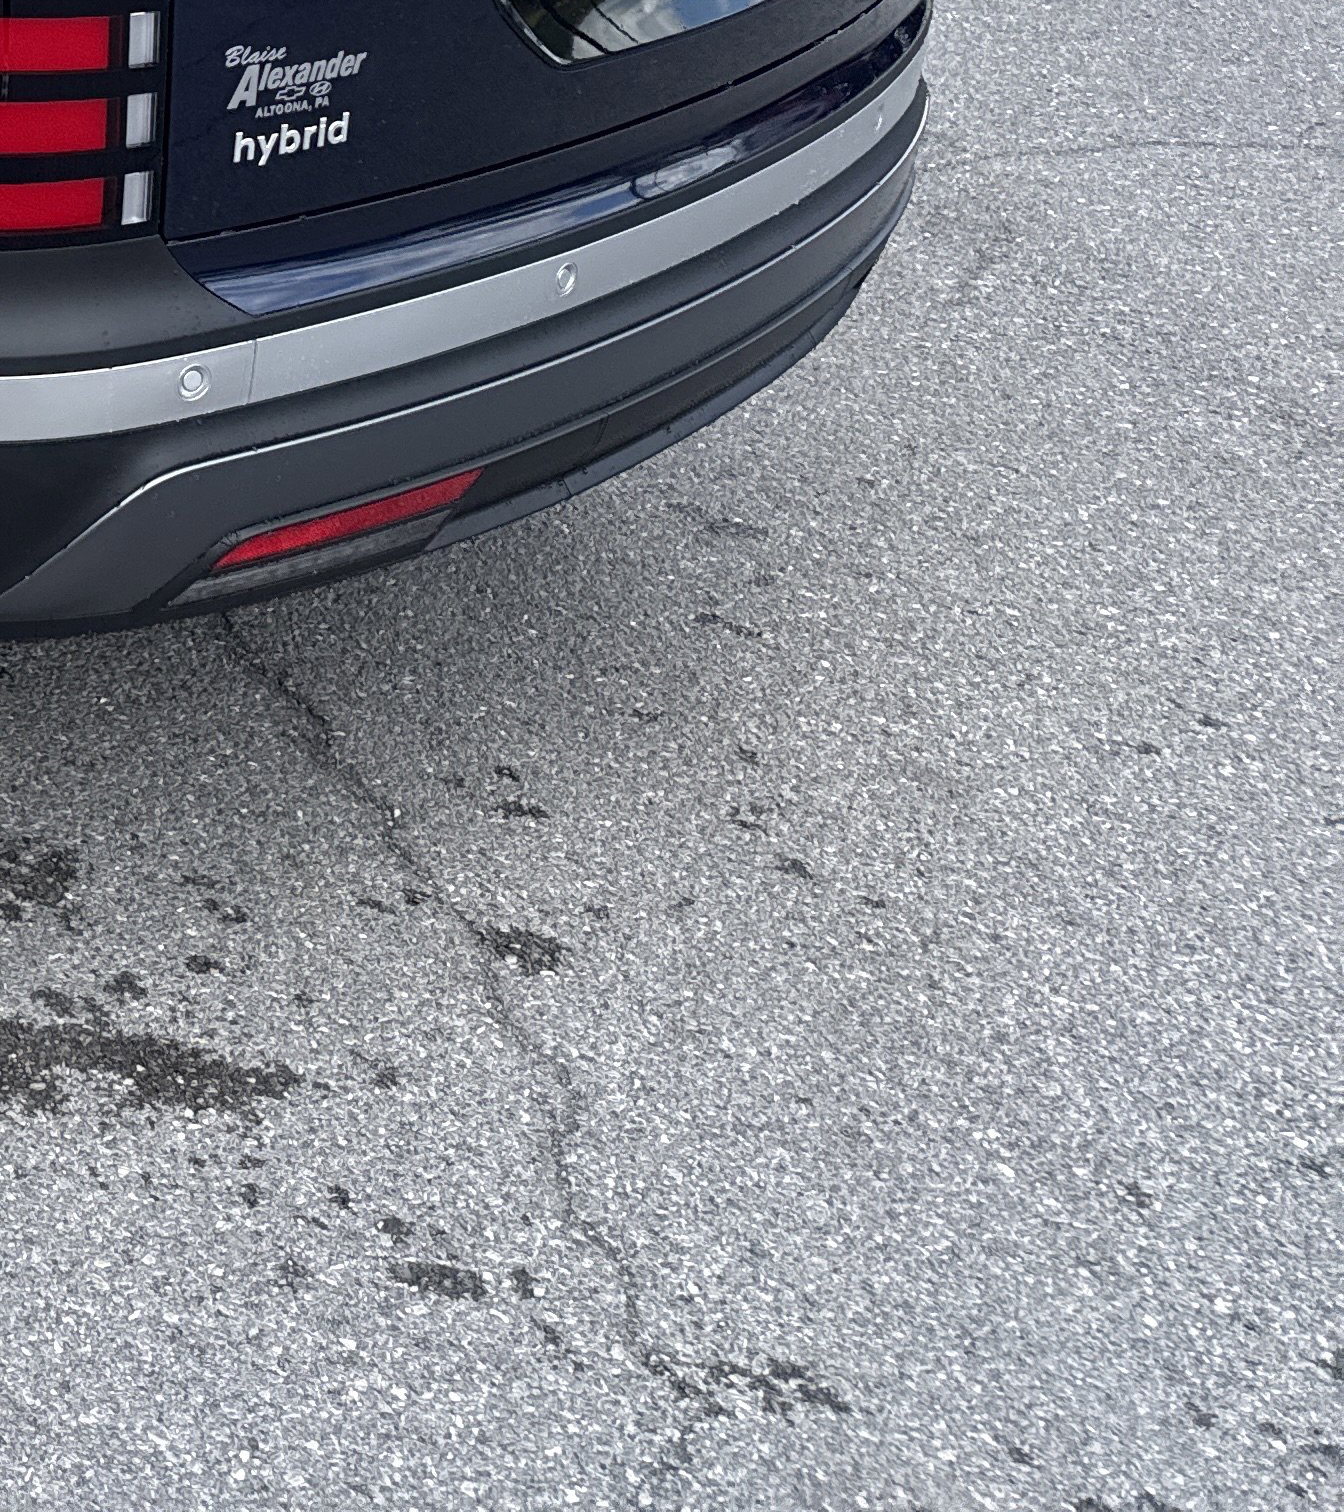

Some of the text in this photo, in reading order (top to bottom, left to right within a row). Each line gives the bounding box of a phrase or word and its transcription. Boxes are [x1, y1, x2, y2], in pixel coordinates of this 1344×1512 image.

[224, 45, 288, 68] Blaise
[226, 50, 368, 110] Alexander
[254, 95, 330, 119] ALTOONA, PA
[232, 111, 351, 167] hybrid
